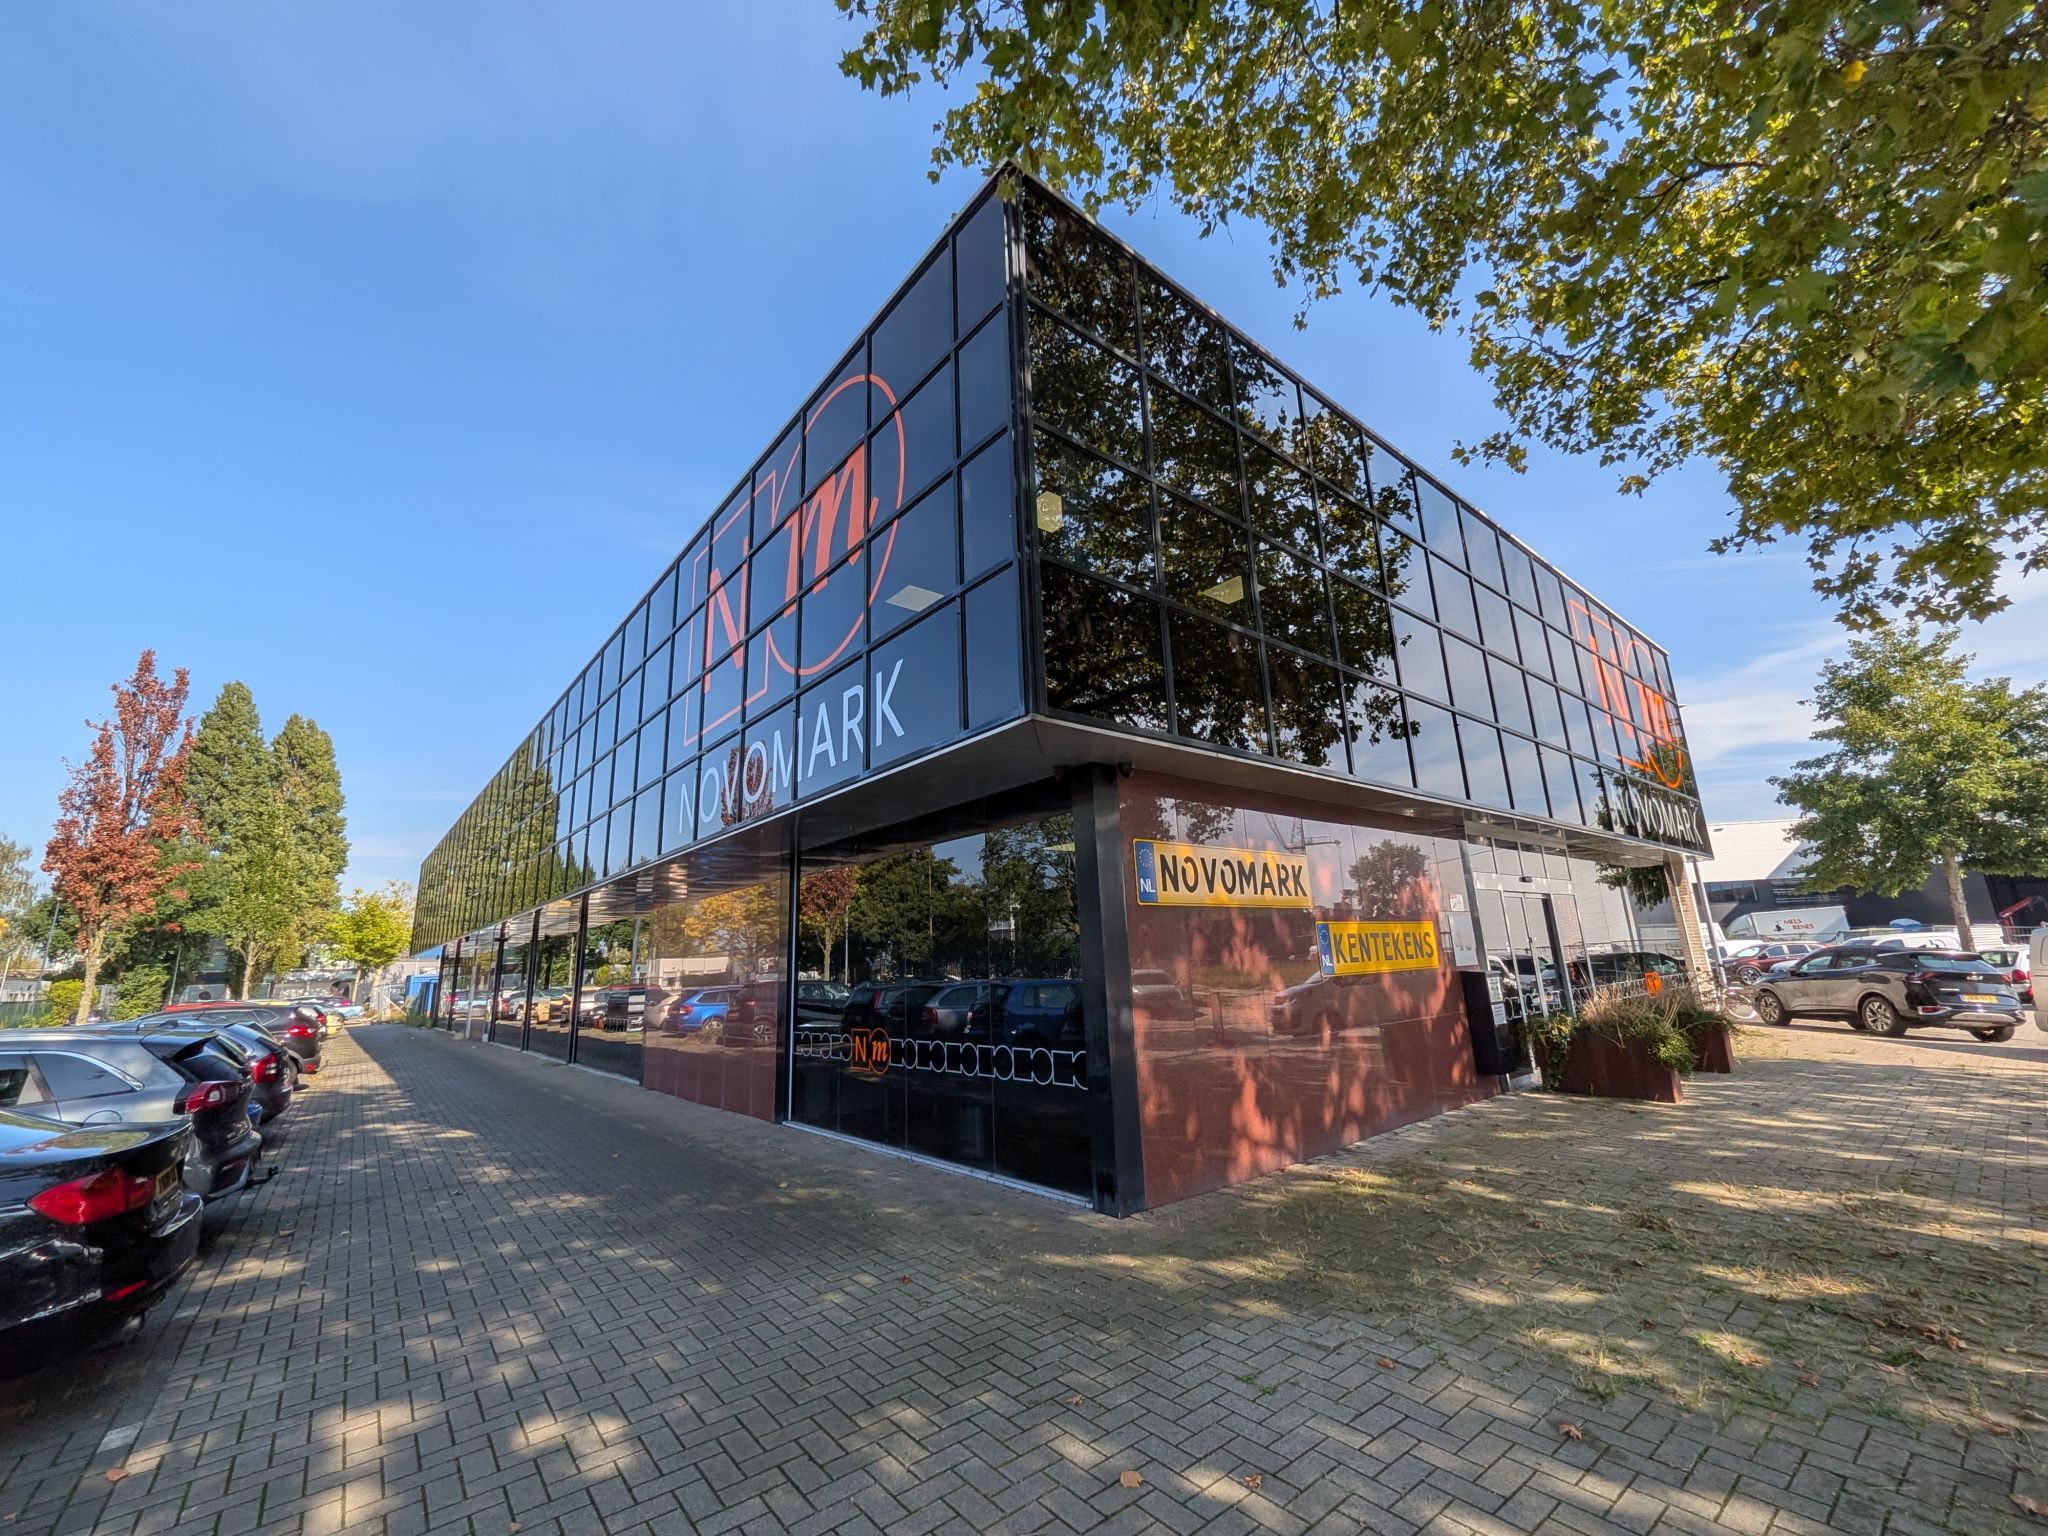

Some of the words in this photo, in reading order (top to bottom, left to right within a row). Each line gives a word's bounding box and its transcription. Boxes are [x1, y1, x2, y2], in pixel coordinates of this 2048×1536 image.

[678, 658, 906, 835] NOVOMARK
[1609, 784, 1704, 845] NOVOMARK
[1140, 878, 1156, 893] NL
[1160, 854, 1308, 897] NOVOMARK
[1322, 955, 1333, 967] NL
[1333, 931, 1434, 964] KENTEKENS
